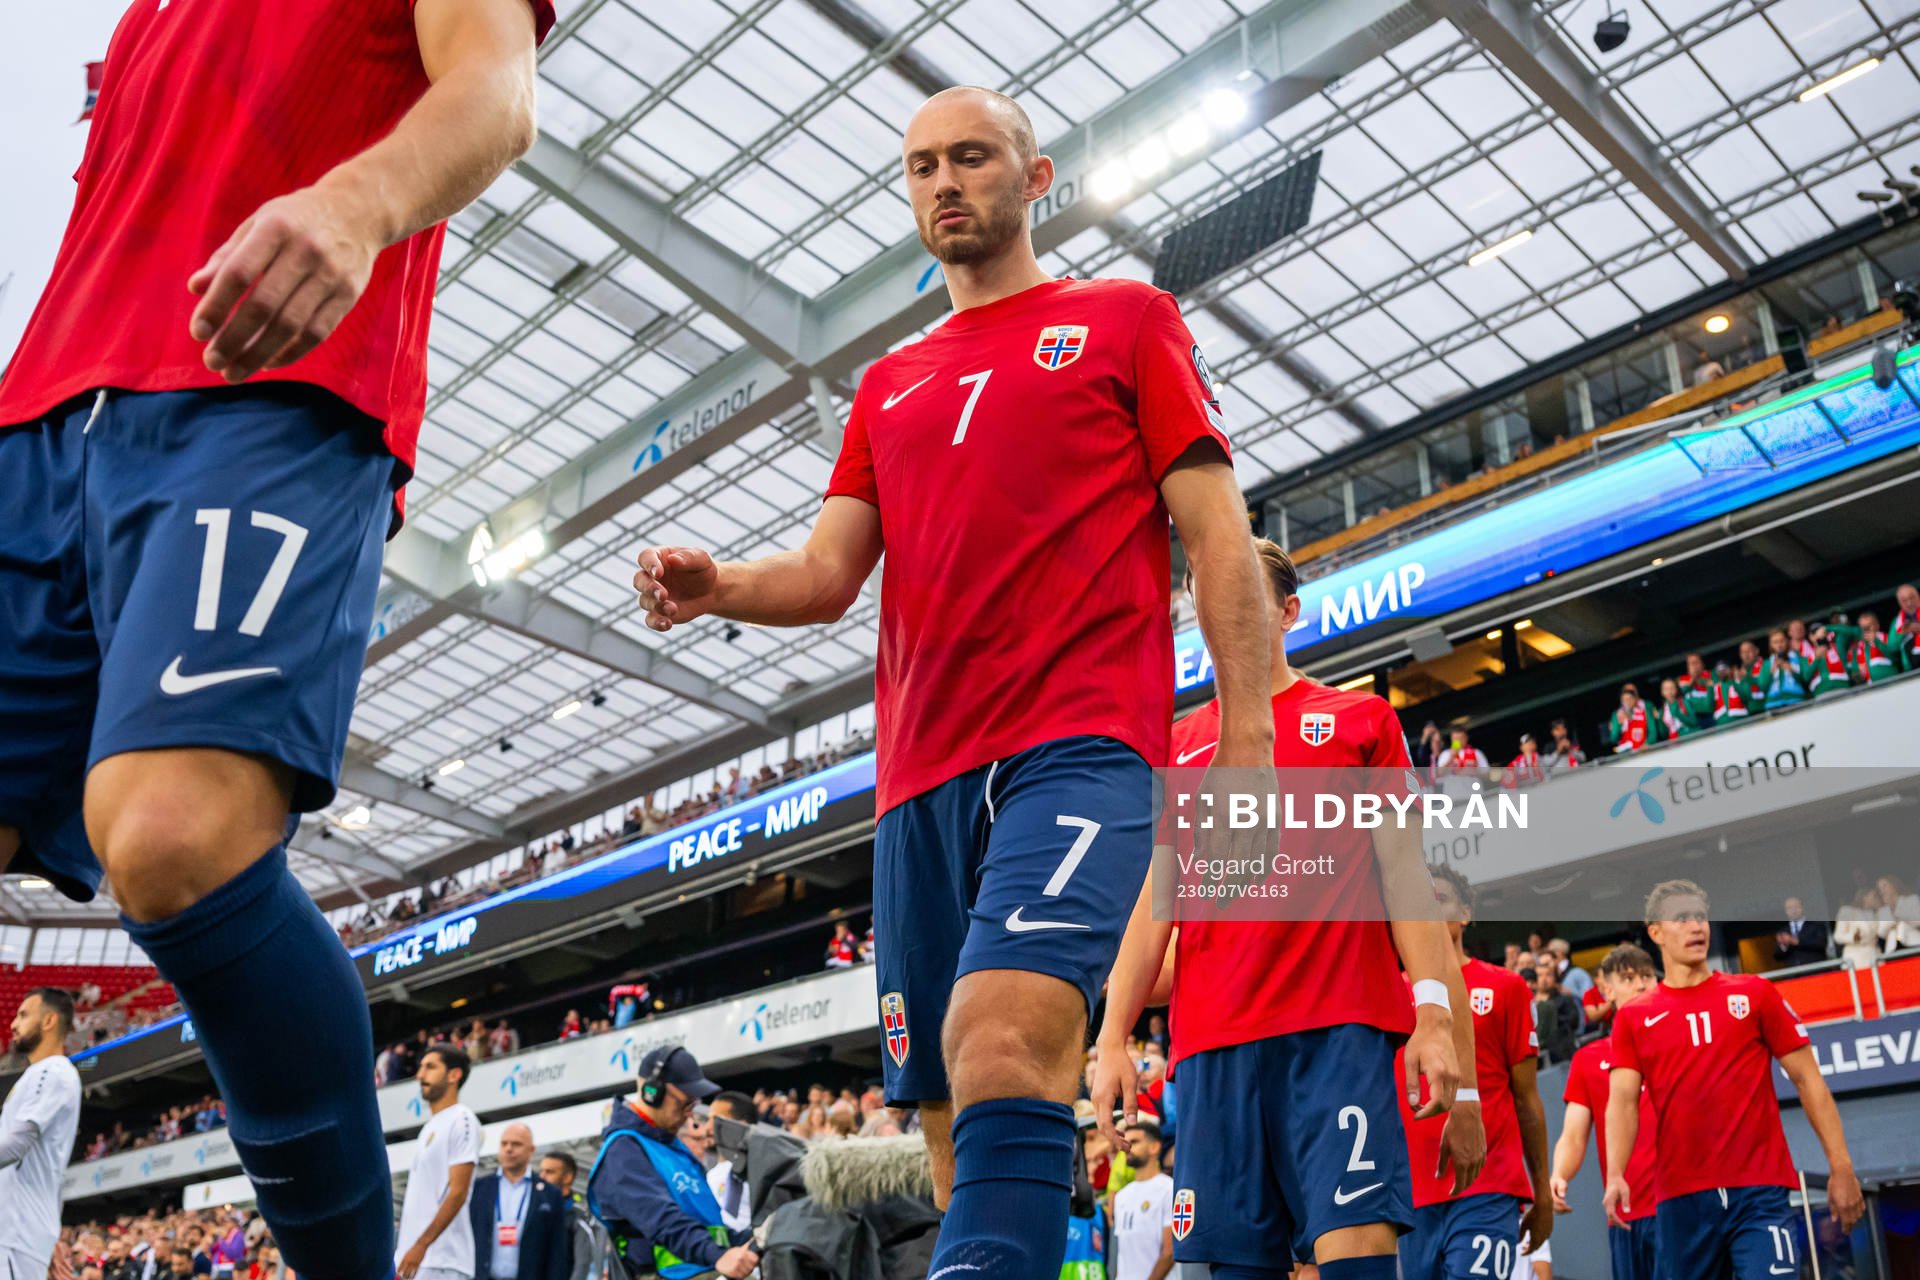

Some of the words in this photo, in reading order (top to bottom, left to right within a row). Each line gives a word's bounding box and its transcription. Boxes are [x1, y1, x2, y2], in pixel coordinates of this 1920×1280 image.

[669, 379, 757, 452] telenor
[951, 368, 994, 446] 7
[193, 507, 310, 637] 17
[1666, 741, 1816, 805] telenor
[668, 817, 743, 874] PEACE
[1042, 814, 1102, 897] 7
[765, 997, 832, 1031] telenor
[1685, 1010, 1713, 1047] 11
[1337, 1105, 1376, 1172] 2
[1469, 1234, 1511, 1280] 20
[1767, 1225, 1795, 1265] 11
